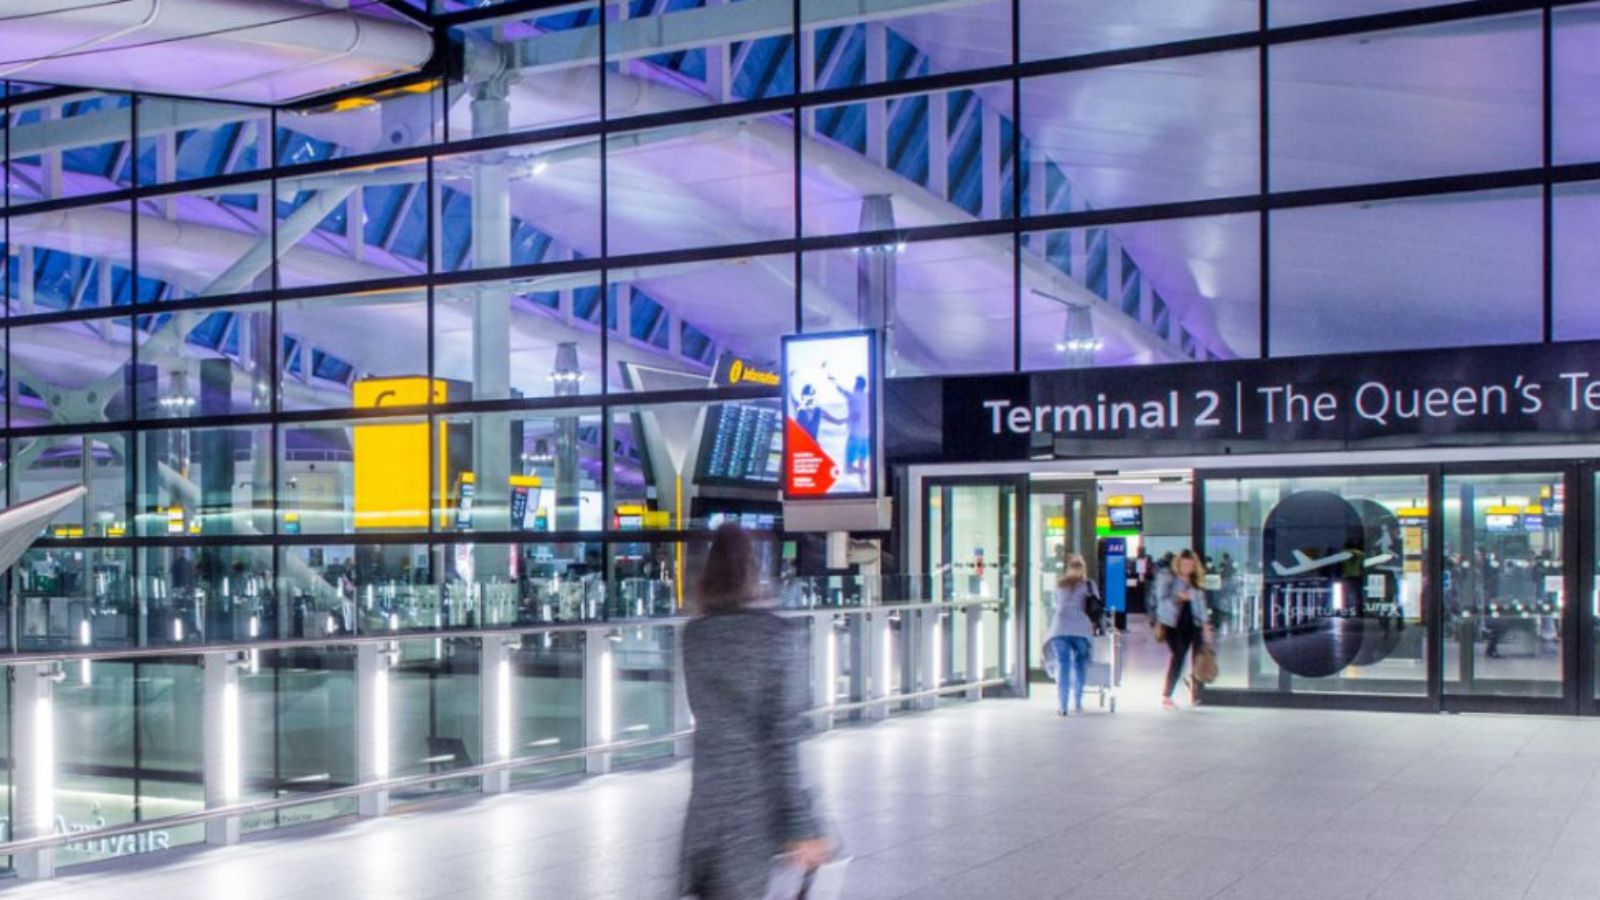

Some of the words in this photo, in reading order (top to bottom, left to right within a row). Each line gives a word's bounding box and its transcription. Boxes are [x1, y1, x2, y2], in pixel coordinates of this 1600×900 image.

[983, 389, 1179, 434] Terminal
[1194, 389, 1221, 426] 2
[1257, 383, 1338, 423] The
[1355, 375, 1543, 426] Queen's
[1271, 603, 1357, 619] Departures
